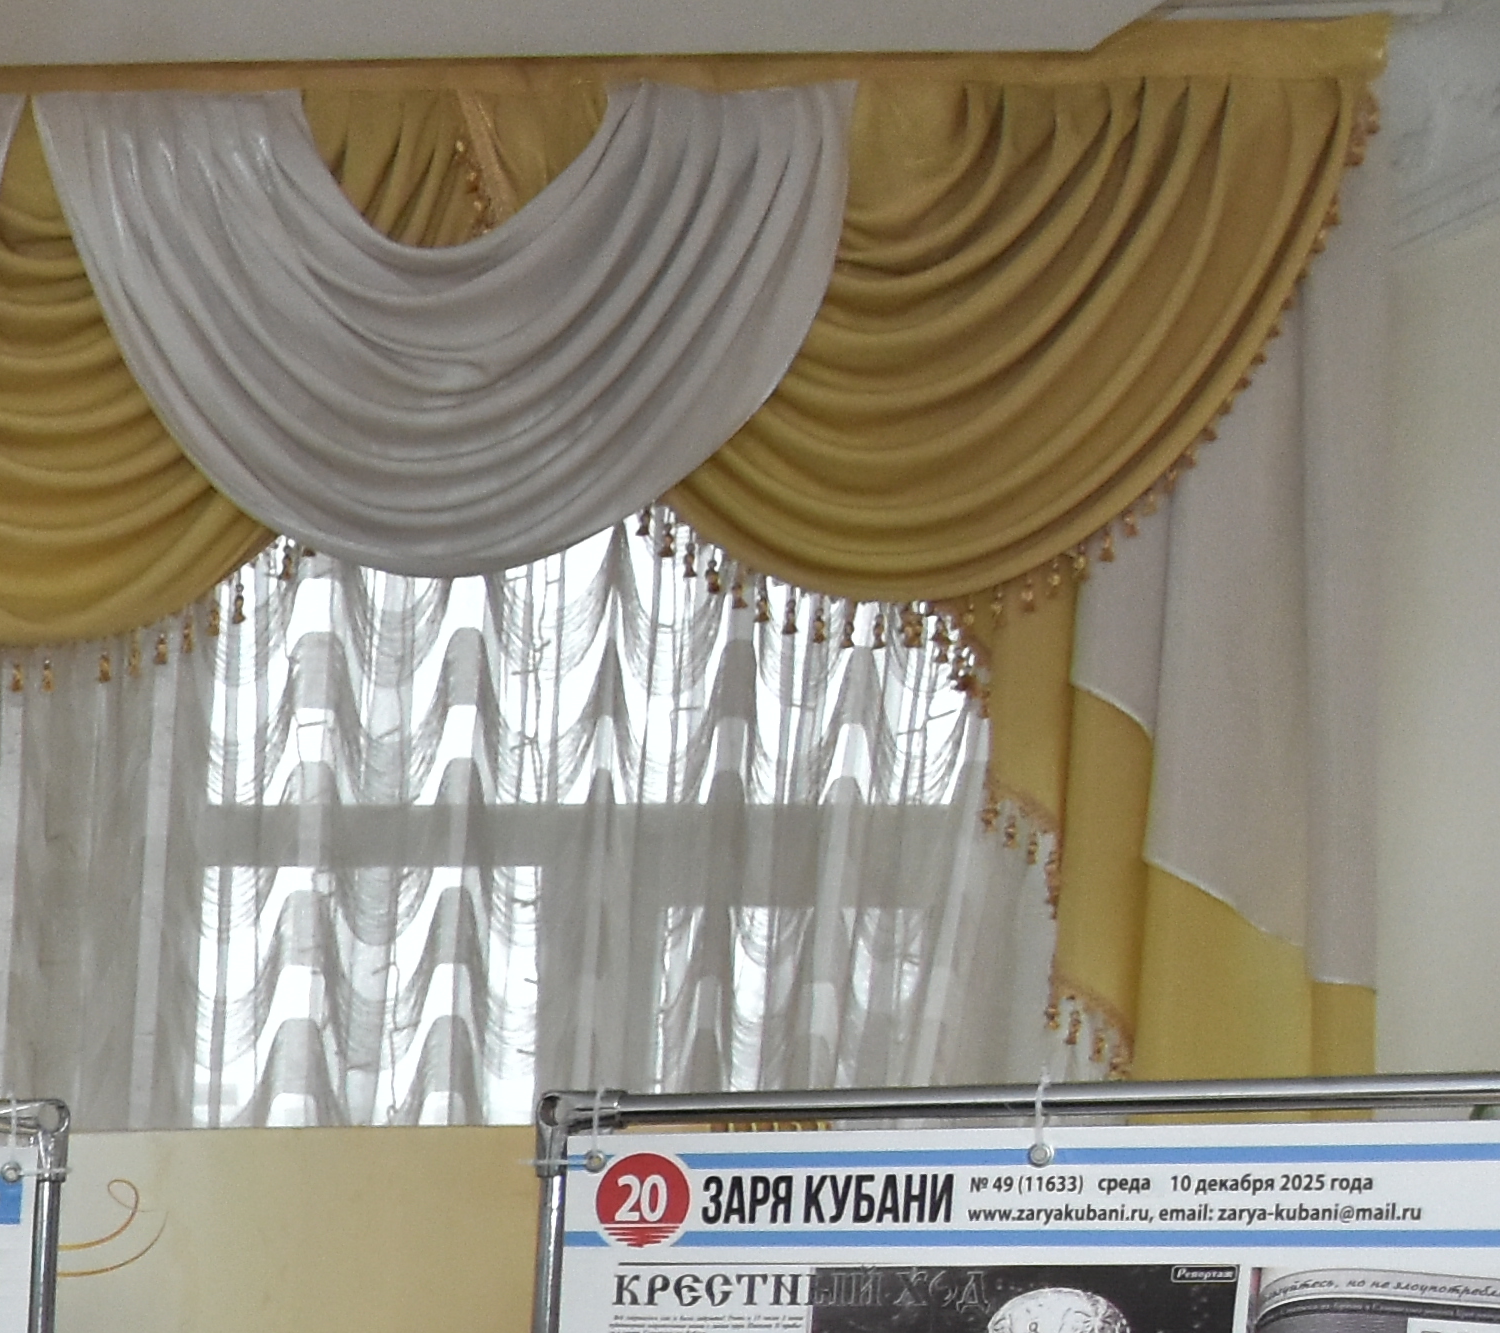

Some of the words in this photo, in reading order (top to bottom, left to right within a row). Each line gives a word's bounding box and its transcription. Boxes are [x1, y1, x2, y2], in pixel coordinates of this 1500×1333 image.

[614, 1172, 669, 1224] 20
[701, 1175, 793, 1224] ЗАРЯ
[803, 1173, 954, 1223] КУБАНИ
[970, 1176, 989, 1193] №
[992, 1175, 1014, 1192] 49
[1018, 1175, 1083, 1195] (11633)
[1097, 1177, 1151, 1195] среда
[1171, 1174, 1191, 1192] 10
[1194, 1173, 1275, 1196] декабря
[1279, 1173, 1325, 1191] 2025
[1330, 1177, 1373, 1194] года
[967, 1203, 1154, 1226] www.zaryakubani.ru,
[1158, 1203, 1214, 1221] email:
[1217, 1202, 1422, 1226] zarya-kubani@mail.ru
